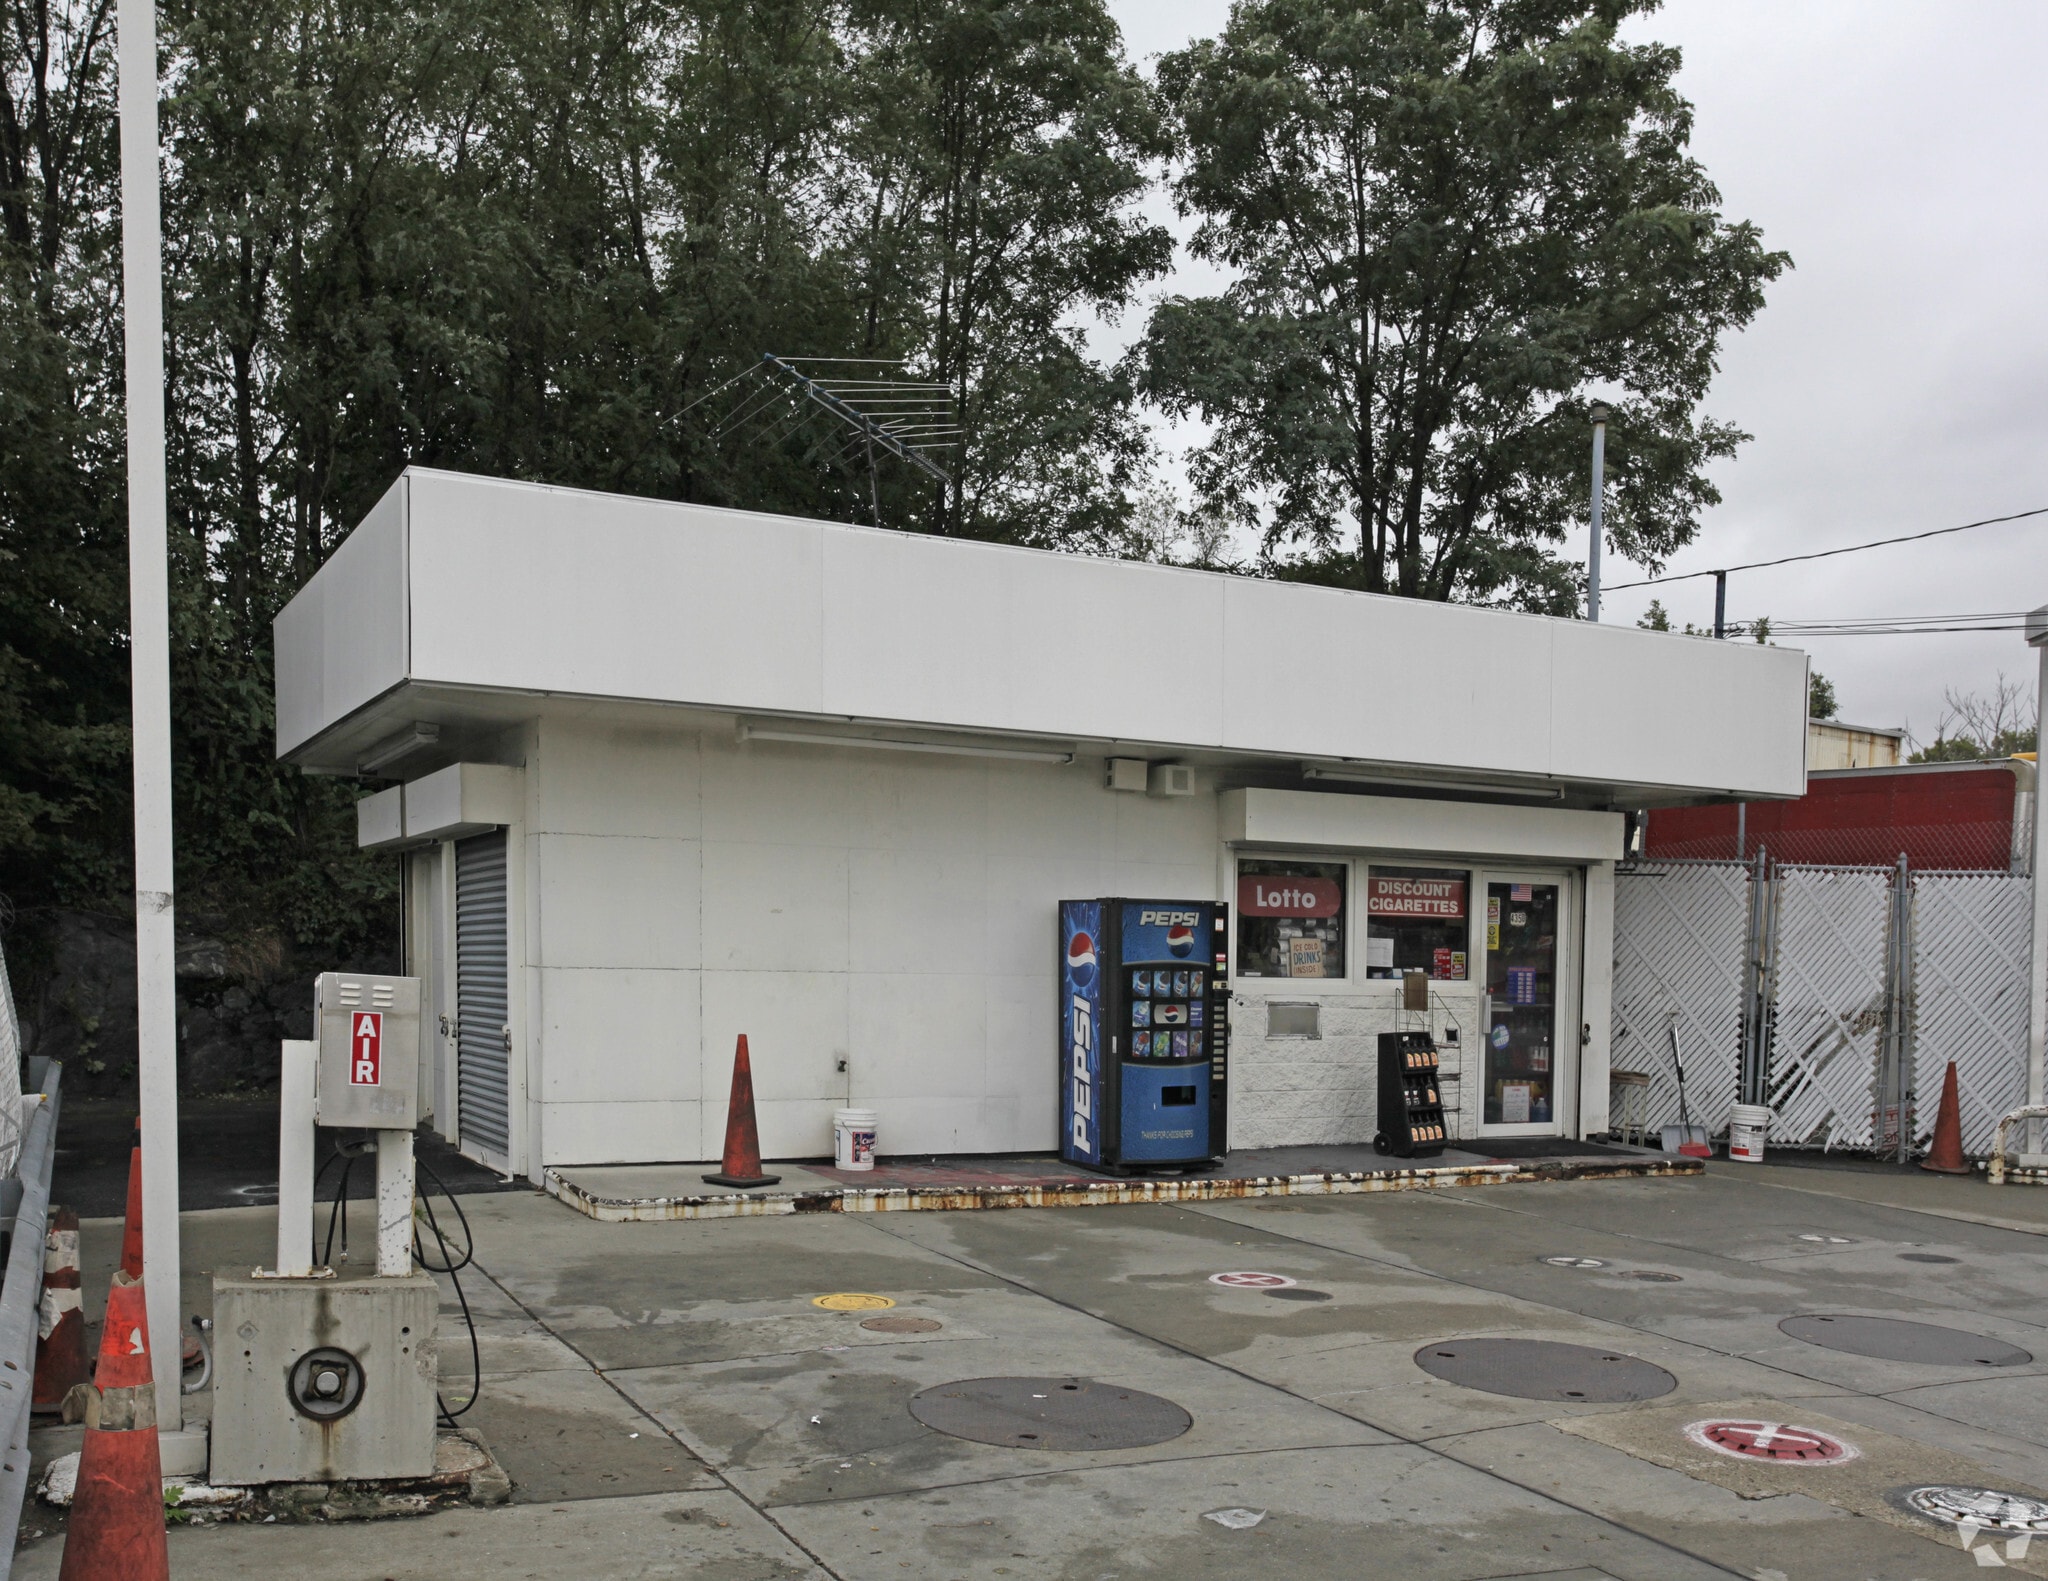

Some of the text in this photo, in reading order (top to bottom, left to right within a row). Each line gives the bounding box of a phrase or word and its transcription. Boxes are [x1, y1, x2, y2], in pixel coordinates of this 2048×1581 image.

[1257, 885, 1316, 909] Lotto
[1378, 881, 1452, 897] DISCOUNT
[1369, 897, 1459, 913] CIGARETTES
[1139, 910, 1200, 927] PEPSI
[1293, 942, 1318, 952] ICE COLD
[1293, 950, 1321, 965] DRINKS
[356, 1015, 377, 1083] AIR
[1073, 993, 1091, 1155] PEPSI
